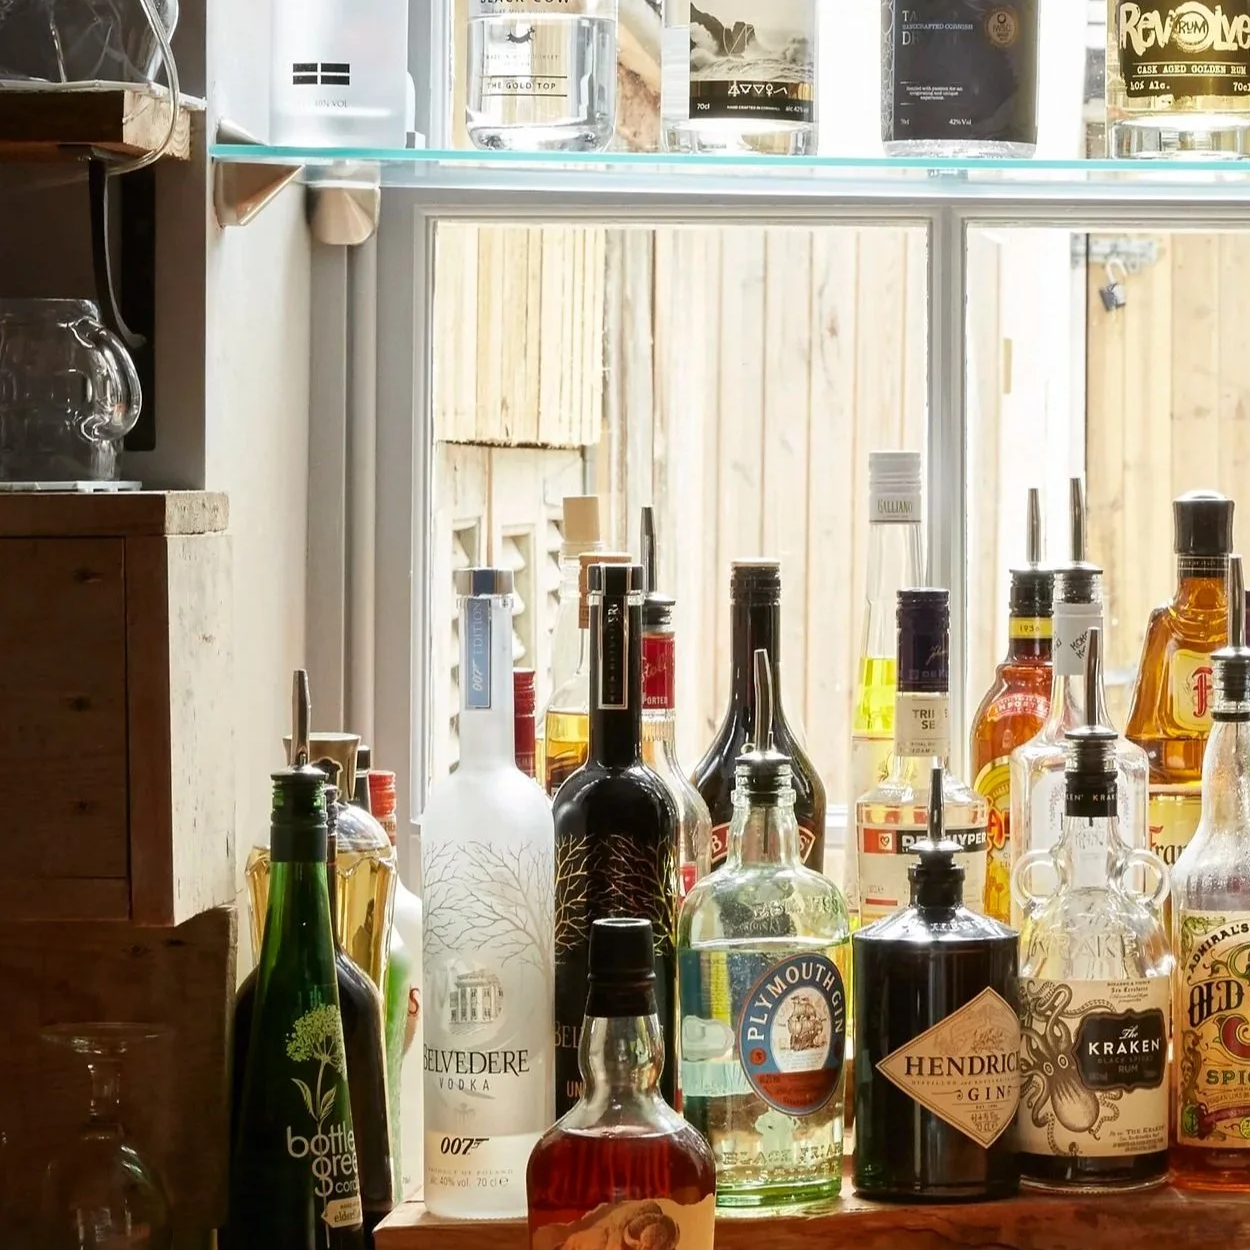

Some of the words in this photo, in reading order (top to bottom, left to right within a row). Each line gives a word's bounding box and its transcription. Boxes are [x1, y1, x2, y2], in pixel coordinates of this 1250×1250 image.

[1178, 20, 1206, 34] RUM
[1137, 65, 1157, 75] CASK
[1162, 65, 1187, 74] AGED
[1191, 64, 1226, 75] GOLDEN
[1230, 65, 1246, 75] RUM
[506, 81, 532, 90] GOLD
[538, 81, 556, 90] TOP
[877, 499, 913, 515] GALLIANO
[473, 602, 484, 654] EDITION
[1188, 922, 1250, 973] ADMIRAL'S
[747, 961, 836, 1041] PLYMOUTH
[1187, 979, 1246, 1029] OLD
[831, 990, 844, 1034] GIN
[1119, 1025, 1140, 1041] The
[1088, 1039, 1160, 1055] KRAKEN
[423, 1044, 530, 1077] BELVEDERE
[1118, 1064, 1138, 1073] RUM
[439, 1078, 490, 1091] VODKA
[967, 1086, 1005, 1101] GIN
[286, 1121, 356, 1158] bottle
[441, 1137, 481, 1155] 007
[312, 1151, 359, 1197] gree
[440, 1175, 455, 1186] 40%
[477, 1175, 488, 1186] 70
